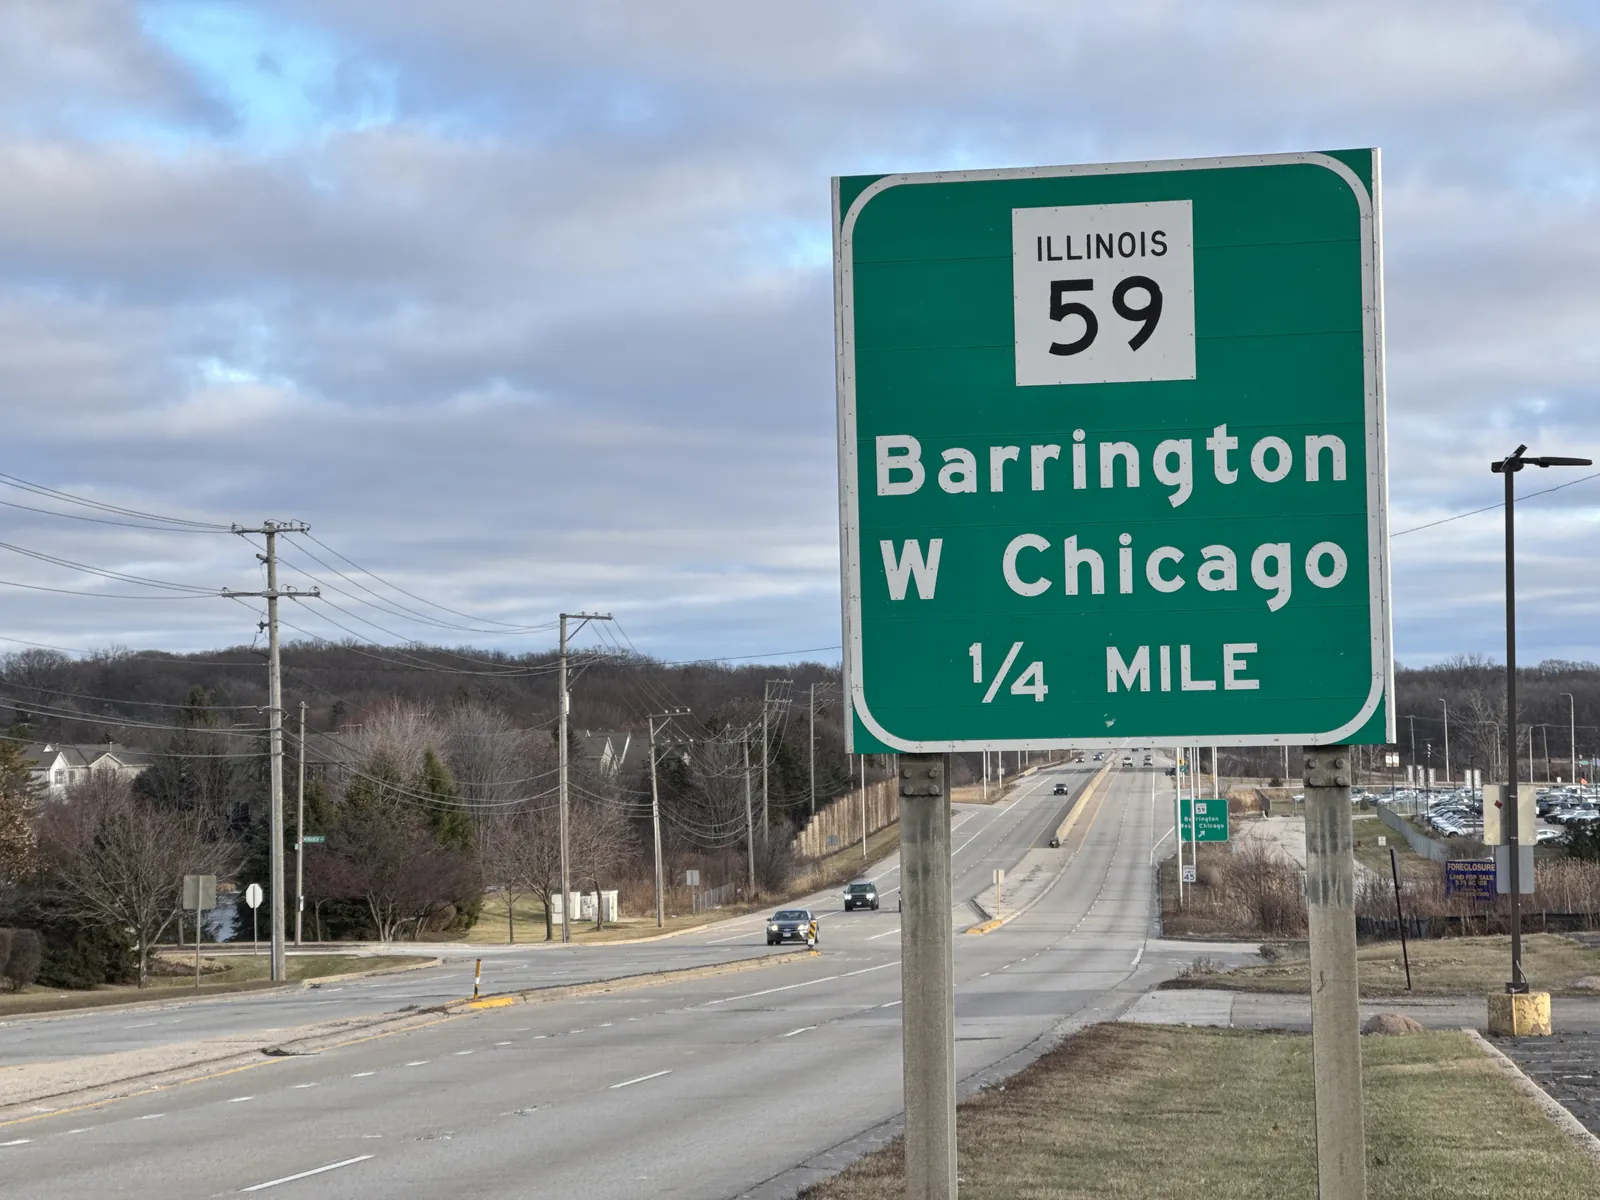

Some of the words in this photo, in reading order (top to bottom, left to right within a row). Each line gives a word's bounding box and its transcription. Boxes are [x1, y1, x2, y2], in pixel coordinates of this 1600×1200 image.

[1037, 230, 1168, 262] ILLINOIS
[1049, 276, 1163, 356] 59
[876, 424, 1347, 508] Barrington
[880, 539, 943, 601] W
[1003, 533, 1348, 612] Chicago
[969, 642, 1049, 704] 1/4
[1107, 643, 1260, 693] MILE
[1448, 863, 1495, 871] FORECLOSURE
